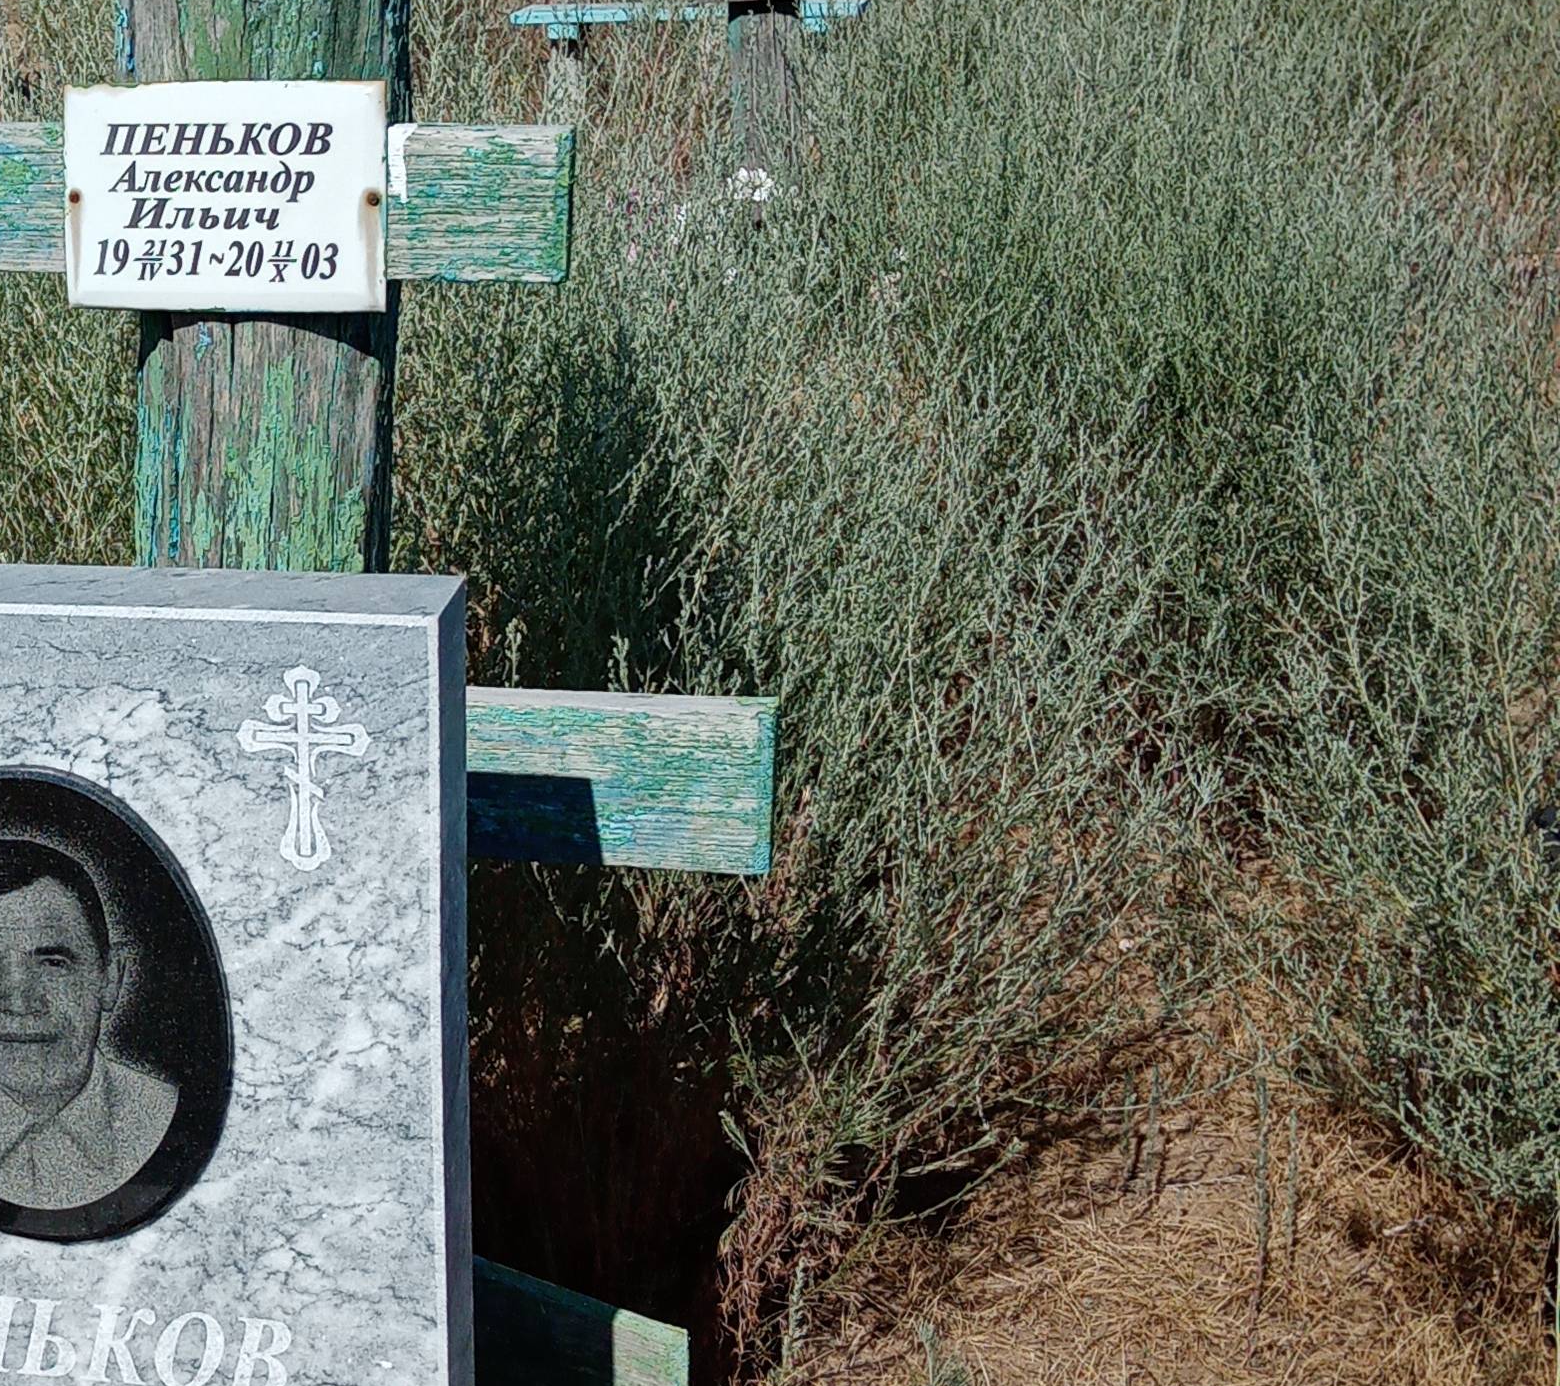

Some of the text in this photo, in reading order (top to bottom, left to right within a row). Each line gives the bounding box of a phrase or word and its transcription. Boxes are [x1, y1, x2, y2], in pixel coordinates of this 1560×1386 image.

[99, 121, 335, 157] ПЕНЬКОВ
[107, 159, 316, 203] Александр
[123, 197, 281, 231] Ильич
